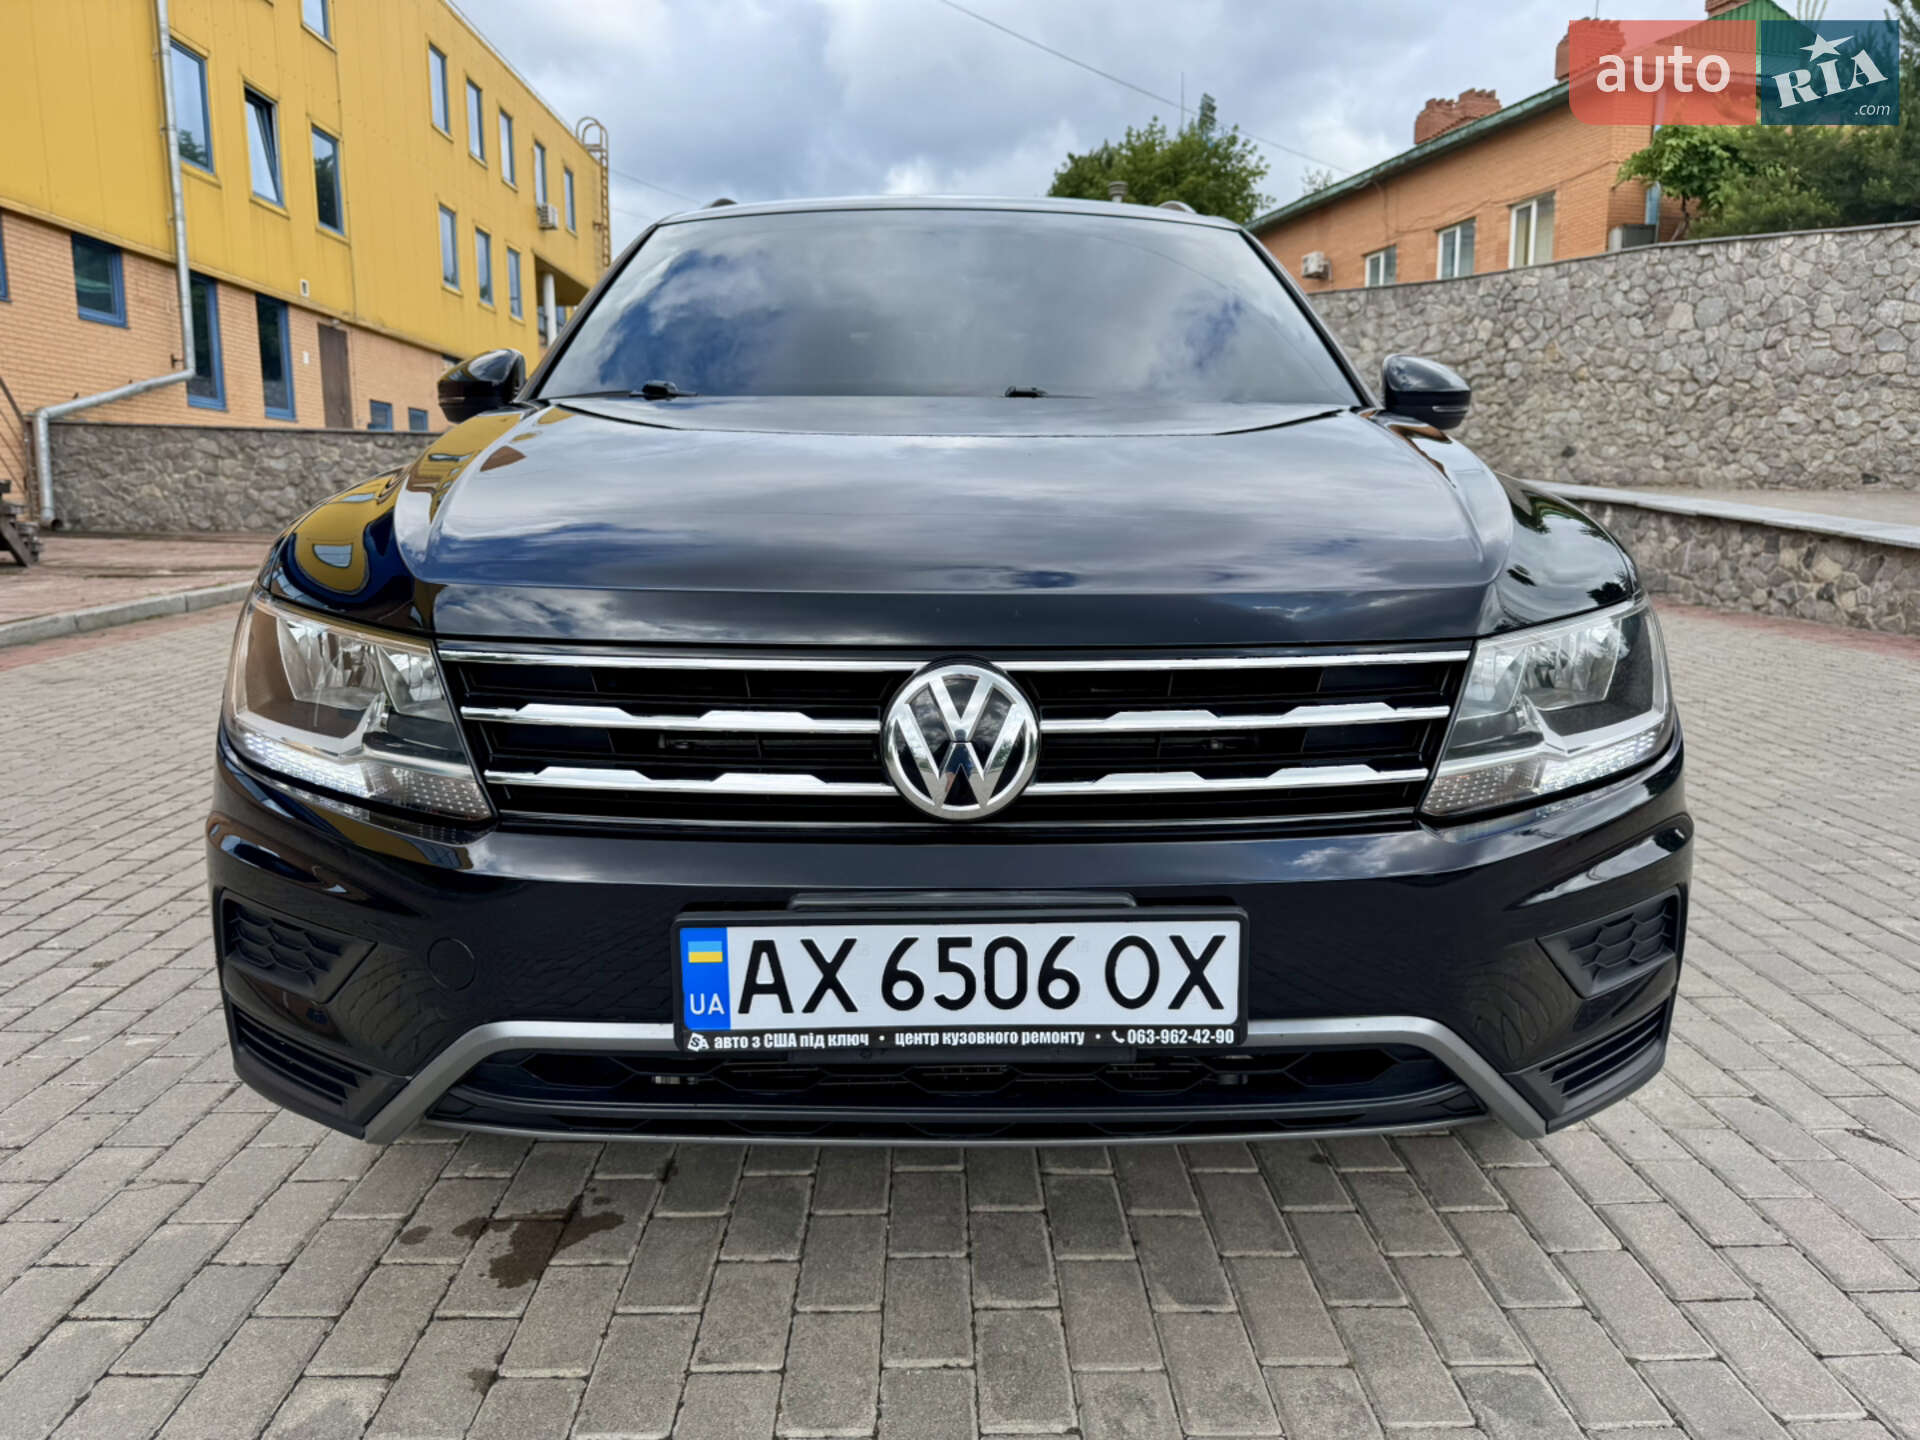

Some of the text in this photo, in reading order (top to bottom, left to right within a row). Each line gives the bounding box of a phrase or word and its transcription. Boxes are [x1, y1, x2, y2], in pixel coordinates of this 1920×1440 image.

[738, 935, 1226, 1014] AX 6506 OX
[690, 993, 725, 1015] UA
[714, 1028, 1235, 1049] авто з США під ключ центр кузовного ремонту 063-962-42-90
